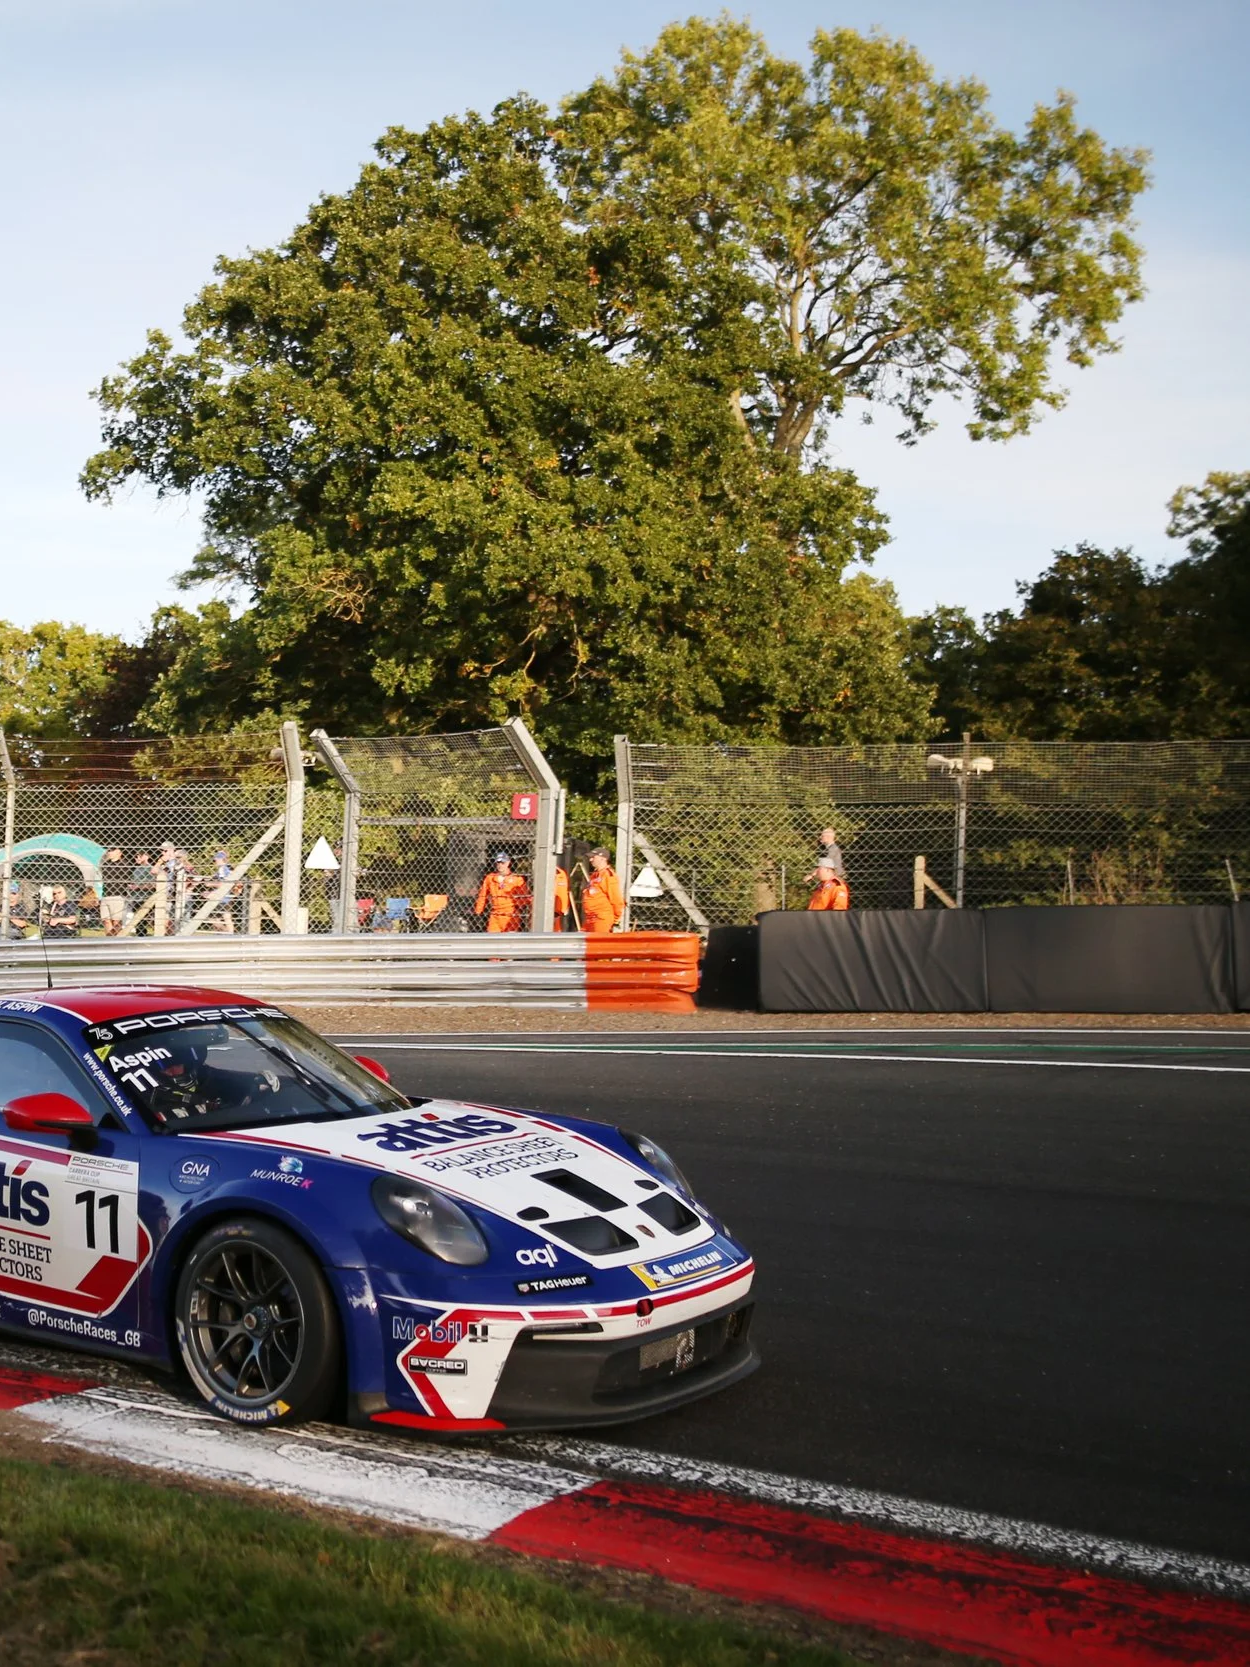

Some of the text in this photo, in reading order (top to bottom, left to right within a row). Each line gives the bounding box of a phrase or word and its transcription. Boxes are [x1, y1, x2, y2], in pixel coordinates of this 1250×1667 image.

[518, 797, 531, 816] 5
[4, 1001, 43, 1013] ASPIN
[113, 1007, 289, 1035] PORSCHE
[108, 1046, 172, 1073] Aspin
[83, 1052, 133, 1117] www.porsche.co.uk
[121, 1068, 159, 1093] 11
[357, 1113, 518, 1152] attis
[72, 1156, 129, 1171] PORSCHE
[421, 1137, 564, 1172] BALANCE SHEET
[462, 1148, 580, 1180] PROTECTORS
[182, 1161, 211, 1177] GNA
[75, 1189, 120, 1254] 11
[9, 1239, 52, 1264] SHEET
[516, 1243, 559, 1268] aql
[667, 1251, 723, 1276] MICHELIN
[28, 1308, 141, 1348] @PorscheRaces_GB
[392, 1316, 462, 1343] Mobil
[636, 1317, 653, 1328] TOW
